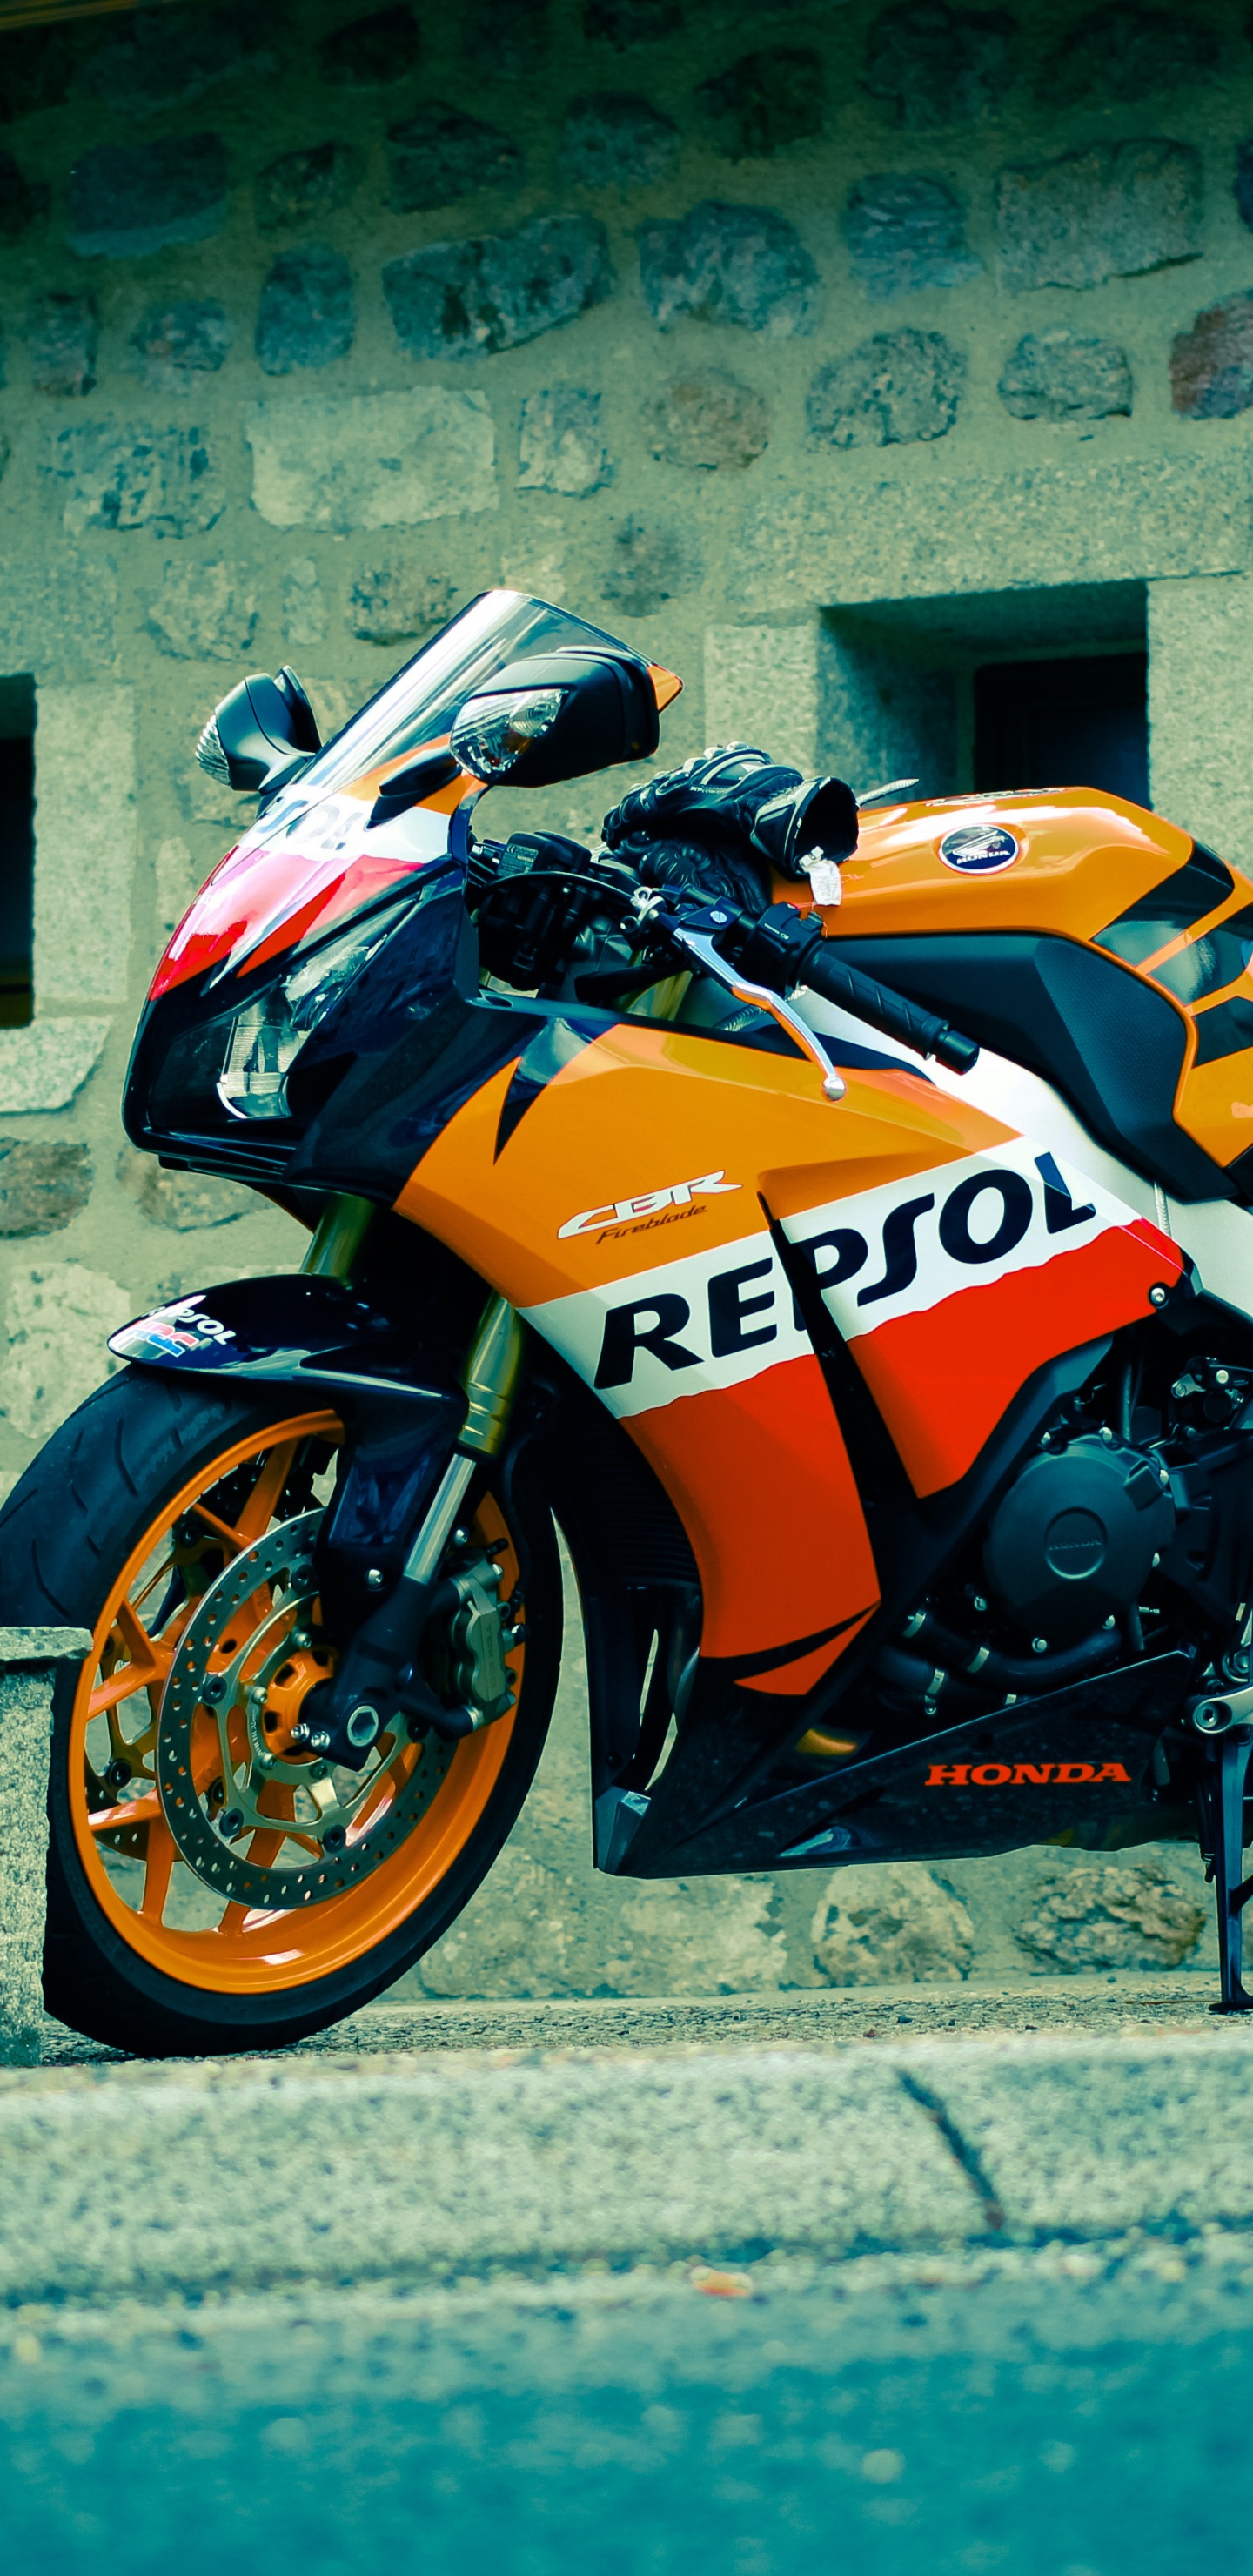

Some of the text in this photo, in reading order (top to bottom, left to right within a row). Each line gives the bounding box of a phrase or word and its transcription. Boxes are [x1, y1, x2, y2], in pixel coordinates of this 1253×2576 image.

[956, 849, 1011, 865] HONDA
[557, 1170, 743, 1239] CBR
[595, 1205, 708, 1245] Fireblade
[593, 1151, 1096, 1391] REPSOL
[924, 1762, 1132, 1786] HONDA
